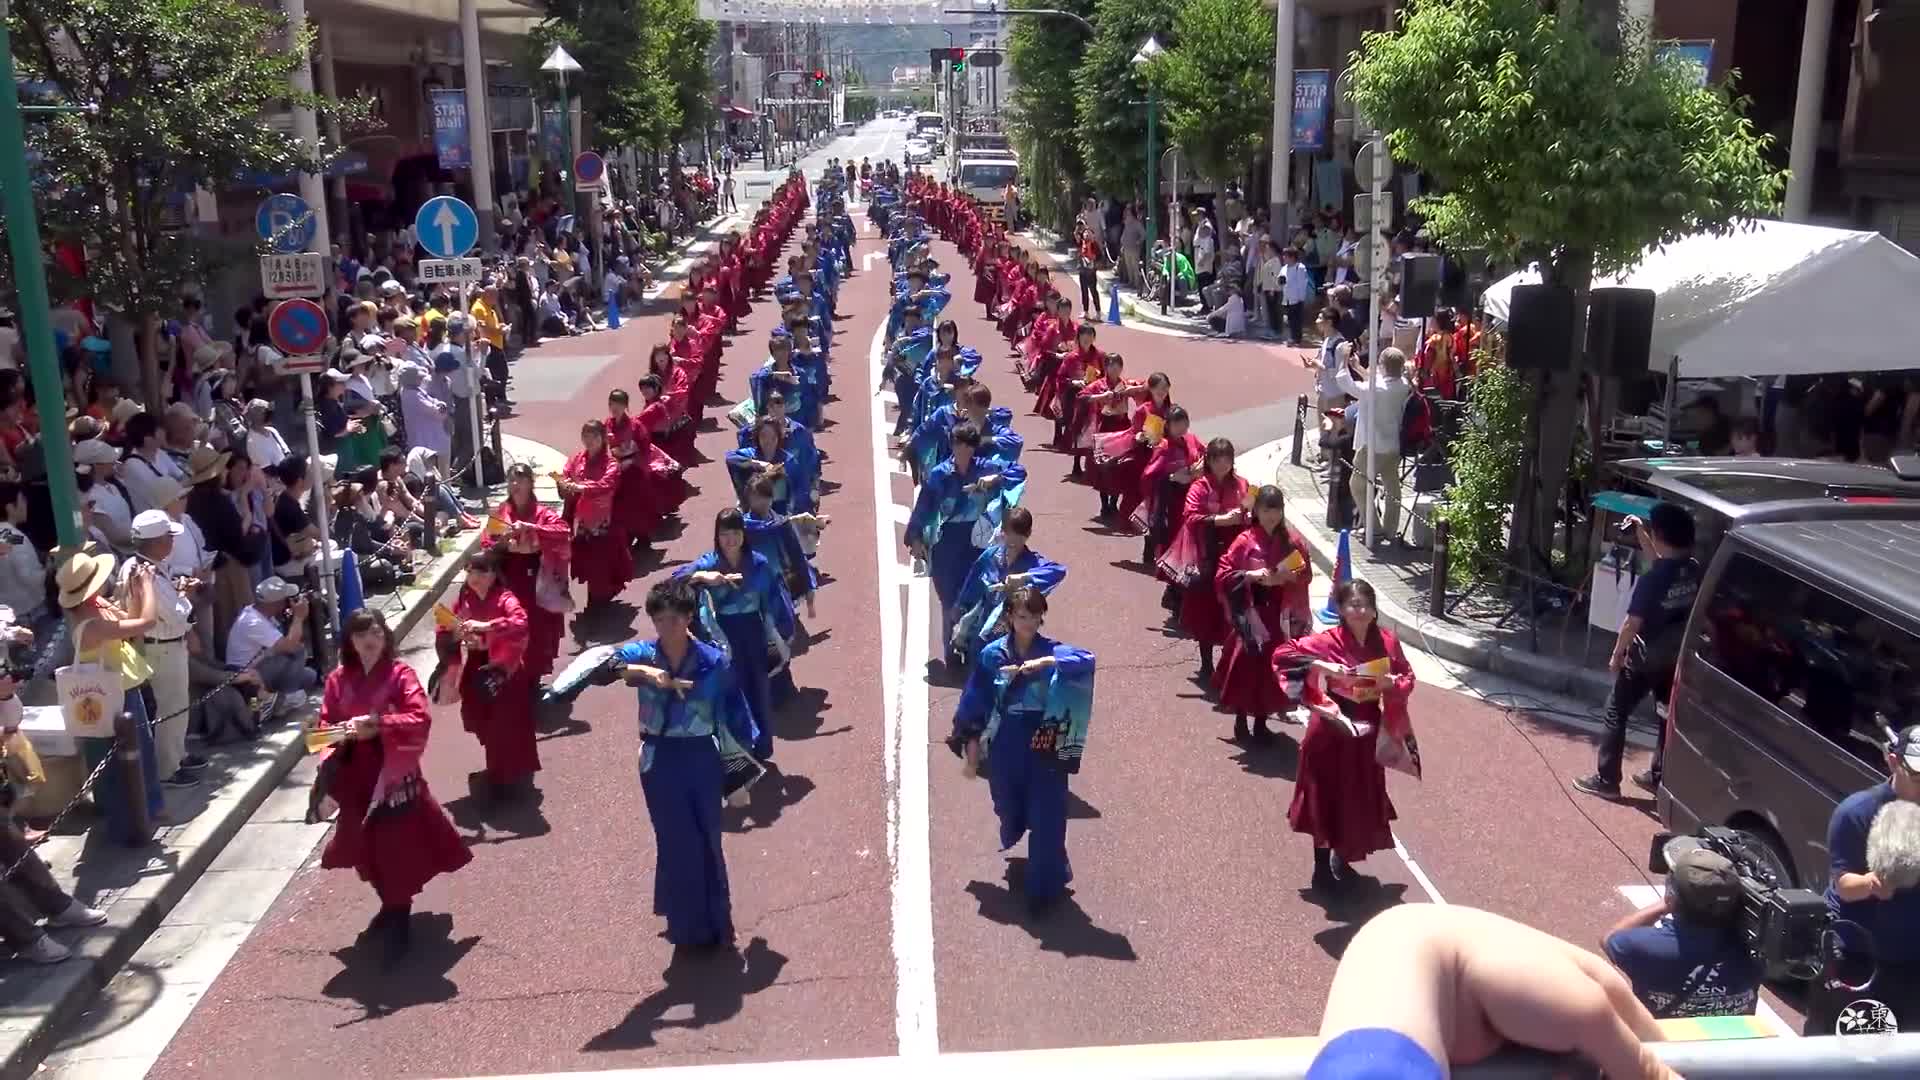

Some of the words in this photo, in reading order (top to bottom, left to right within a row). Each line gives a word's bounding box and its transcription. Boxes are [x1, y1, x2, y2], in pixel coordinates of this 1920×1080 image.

[1295, 85, 1327, 97] STAR
[1295, 97, 1321, 109] Mall
[434, 104, 465, 117] STAR
[435, 117, 463, 129] Mall
[270, 210, 293, 245] P
[288, 228, 306, 246] 60
[424, 263, 479, 279] 自転車を除く
